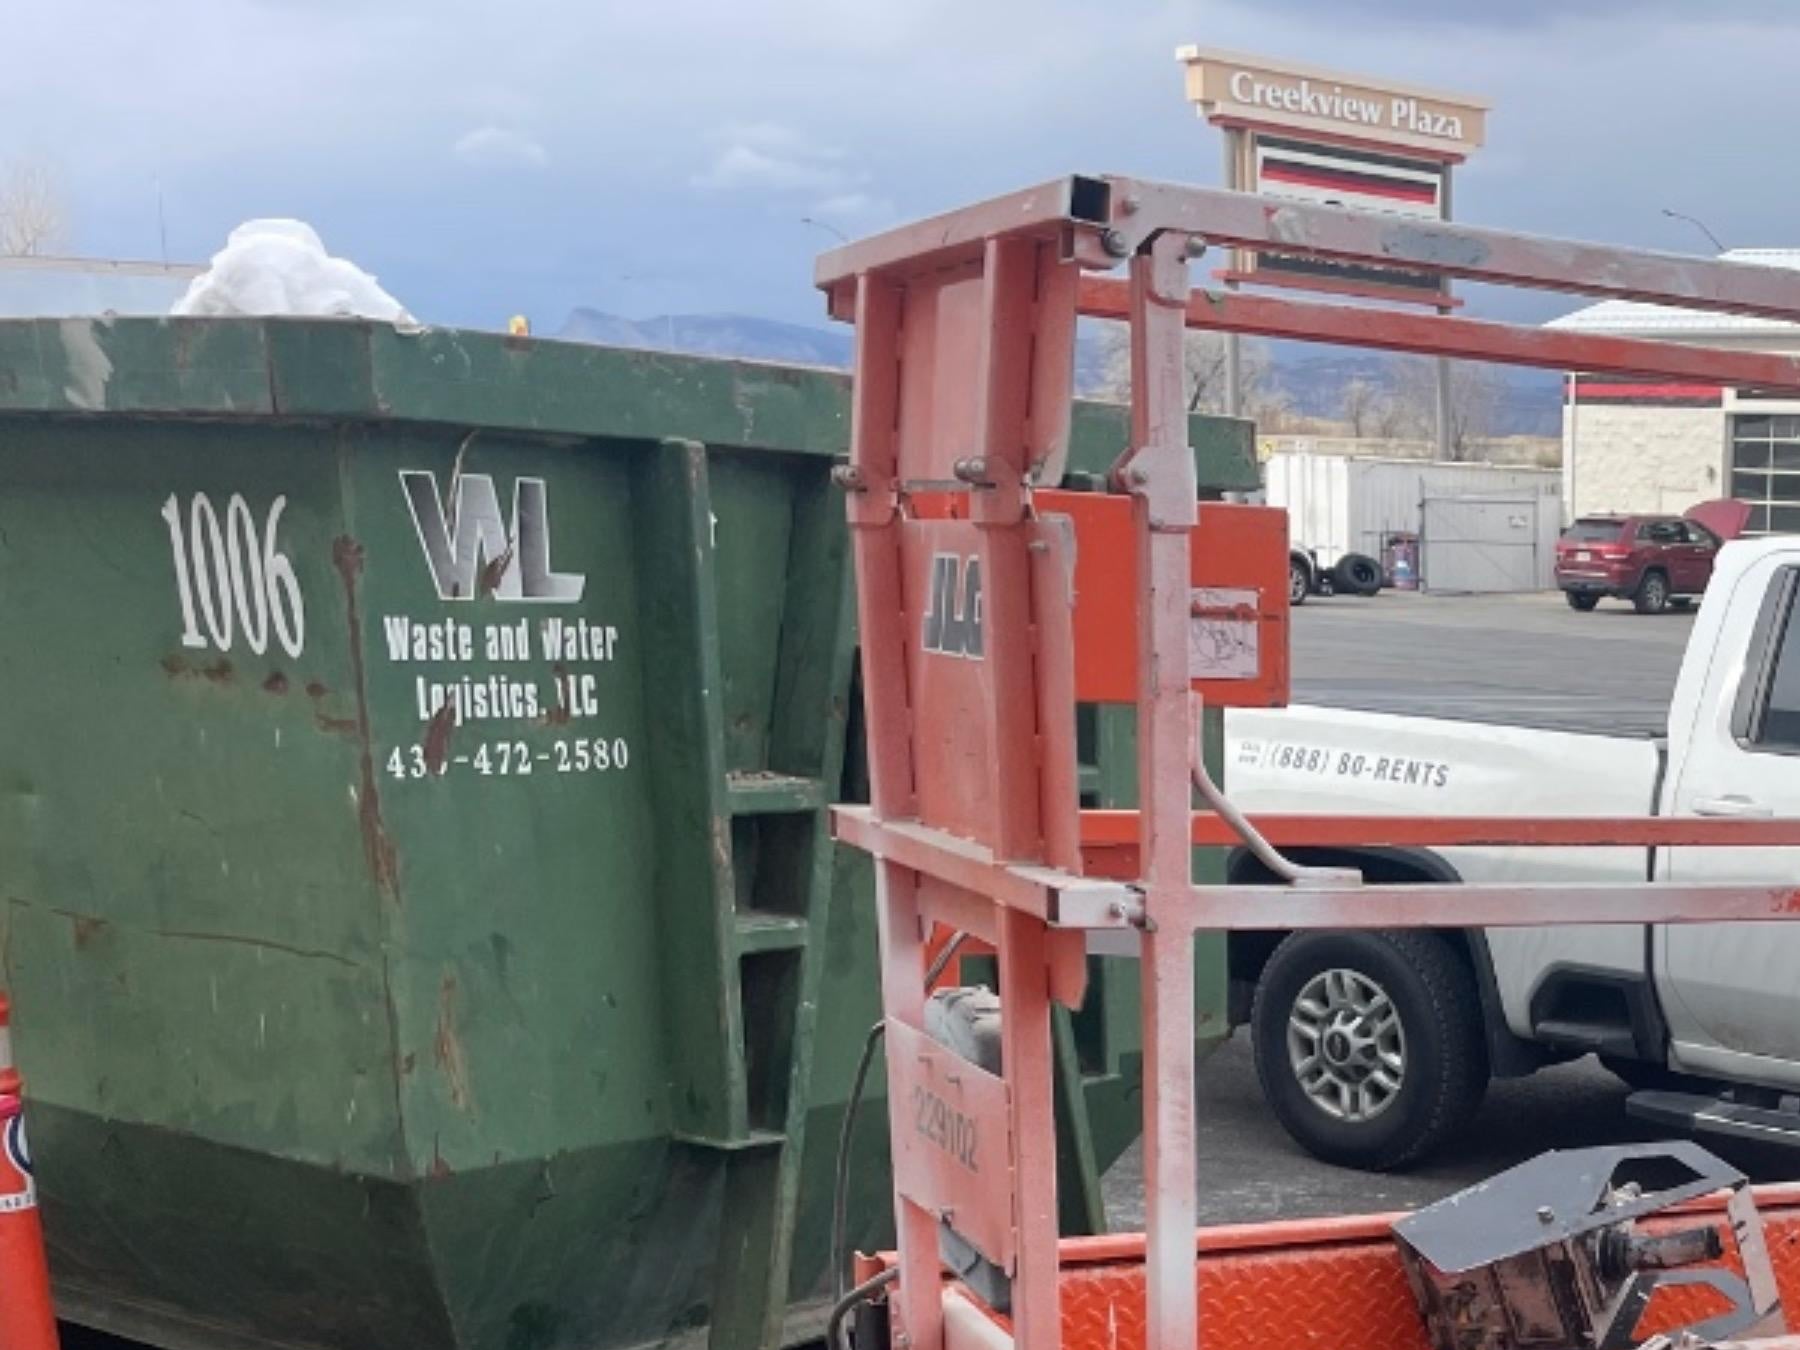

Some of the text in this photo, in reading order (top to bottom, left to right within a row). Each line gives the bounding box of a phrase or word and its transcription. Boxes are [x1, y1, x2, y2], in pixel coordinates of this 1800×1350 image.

[1229, 71, 1463, 141] Creekview Plaza
[160, 491, 304, 660] 1006
[384, 615, 618, 661] Waste and Water
[386, 737, 629, 779] 43-472-2580
[1271, 743, 1330, 775] (888)
[1336, 751, 1450, 788] 80-RENTS
